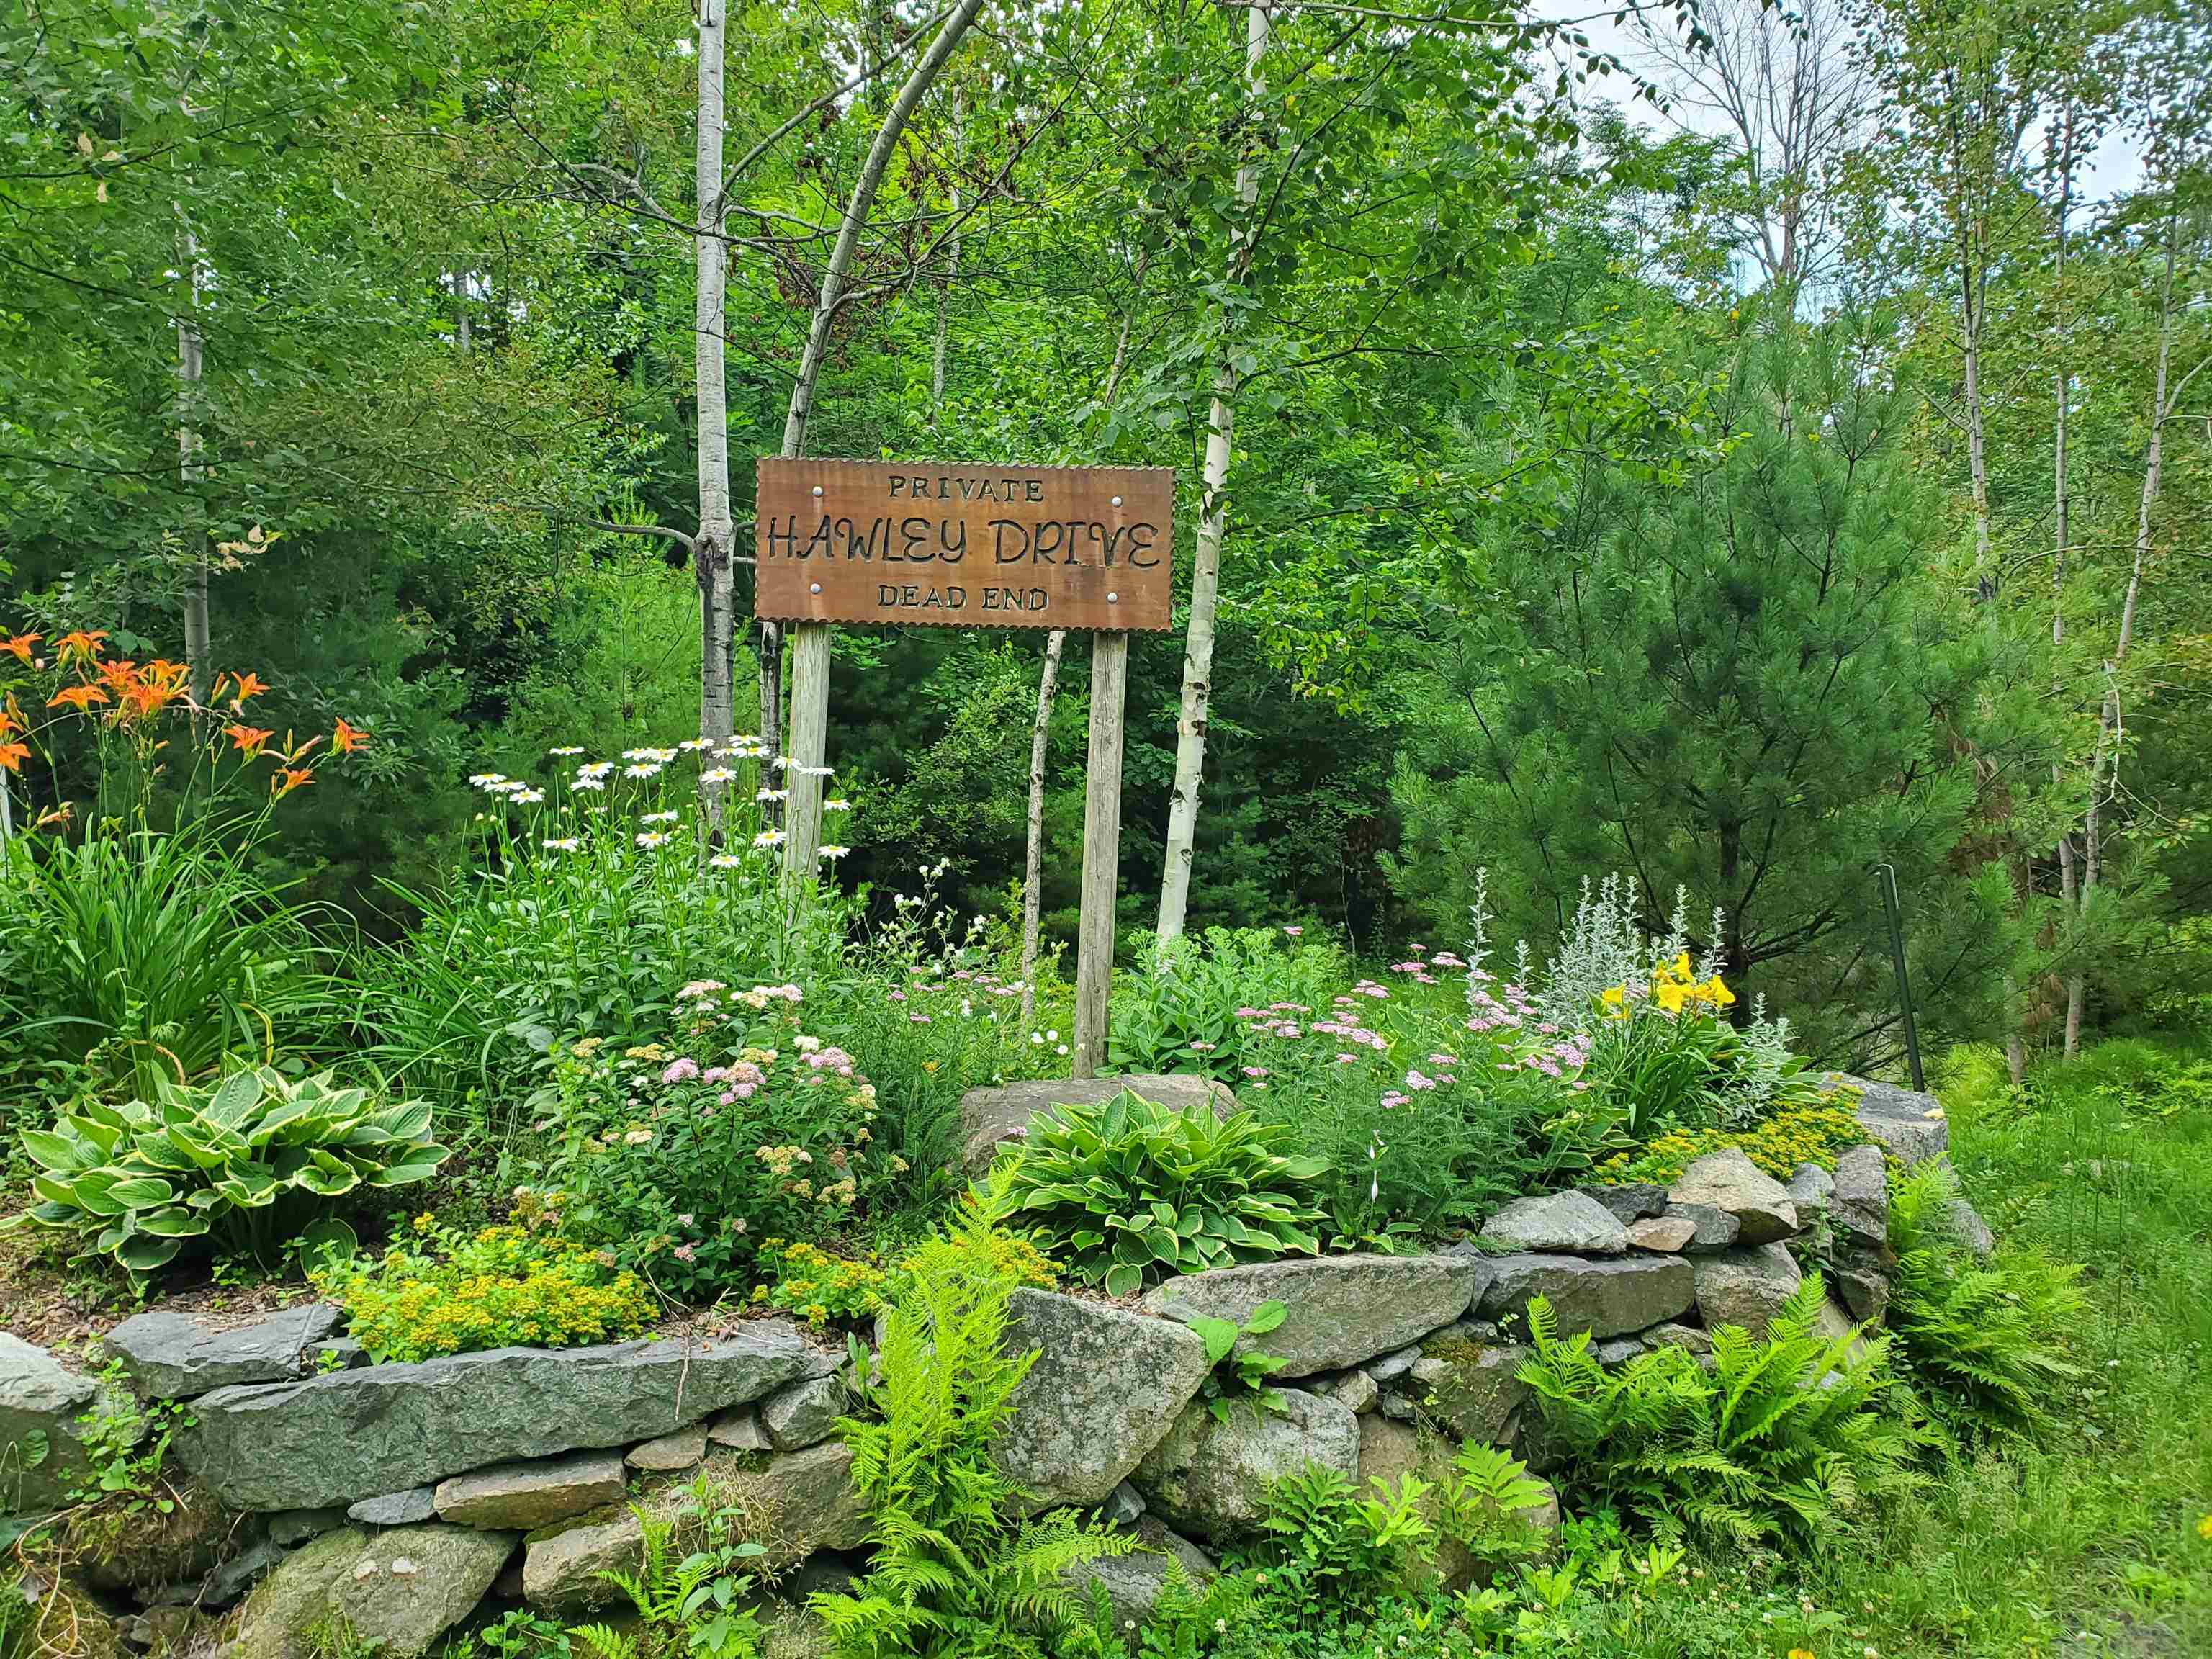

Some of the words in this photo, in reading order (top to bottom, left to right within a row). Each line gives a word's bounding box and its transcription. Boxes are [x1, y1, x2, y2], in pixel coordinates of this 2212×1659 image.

[888, 476, 1044, 503] PRIVATE
[768, 515, 966, 563] HAWLEY
[989, 519, 1160, 570] DRIVE
[878, 584, 966, 609] DEAD
[981, 587, 1049, 611] END
